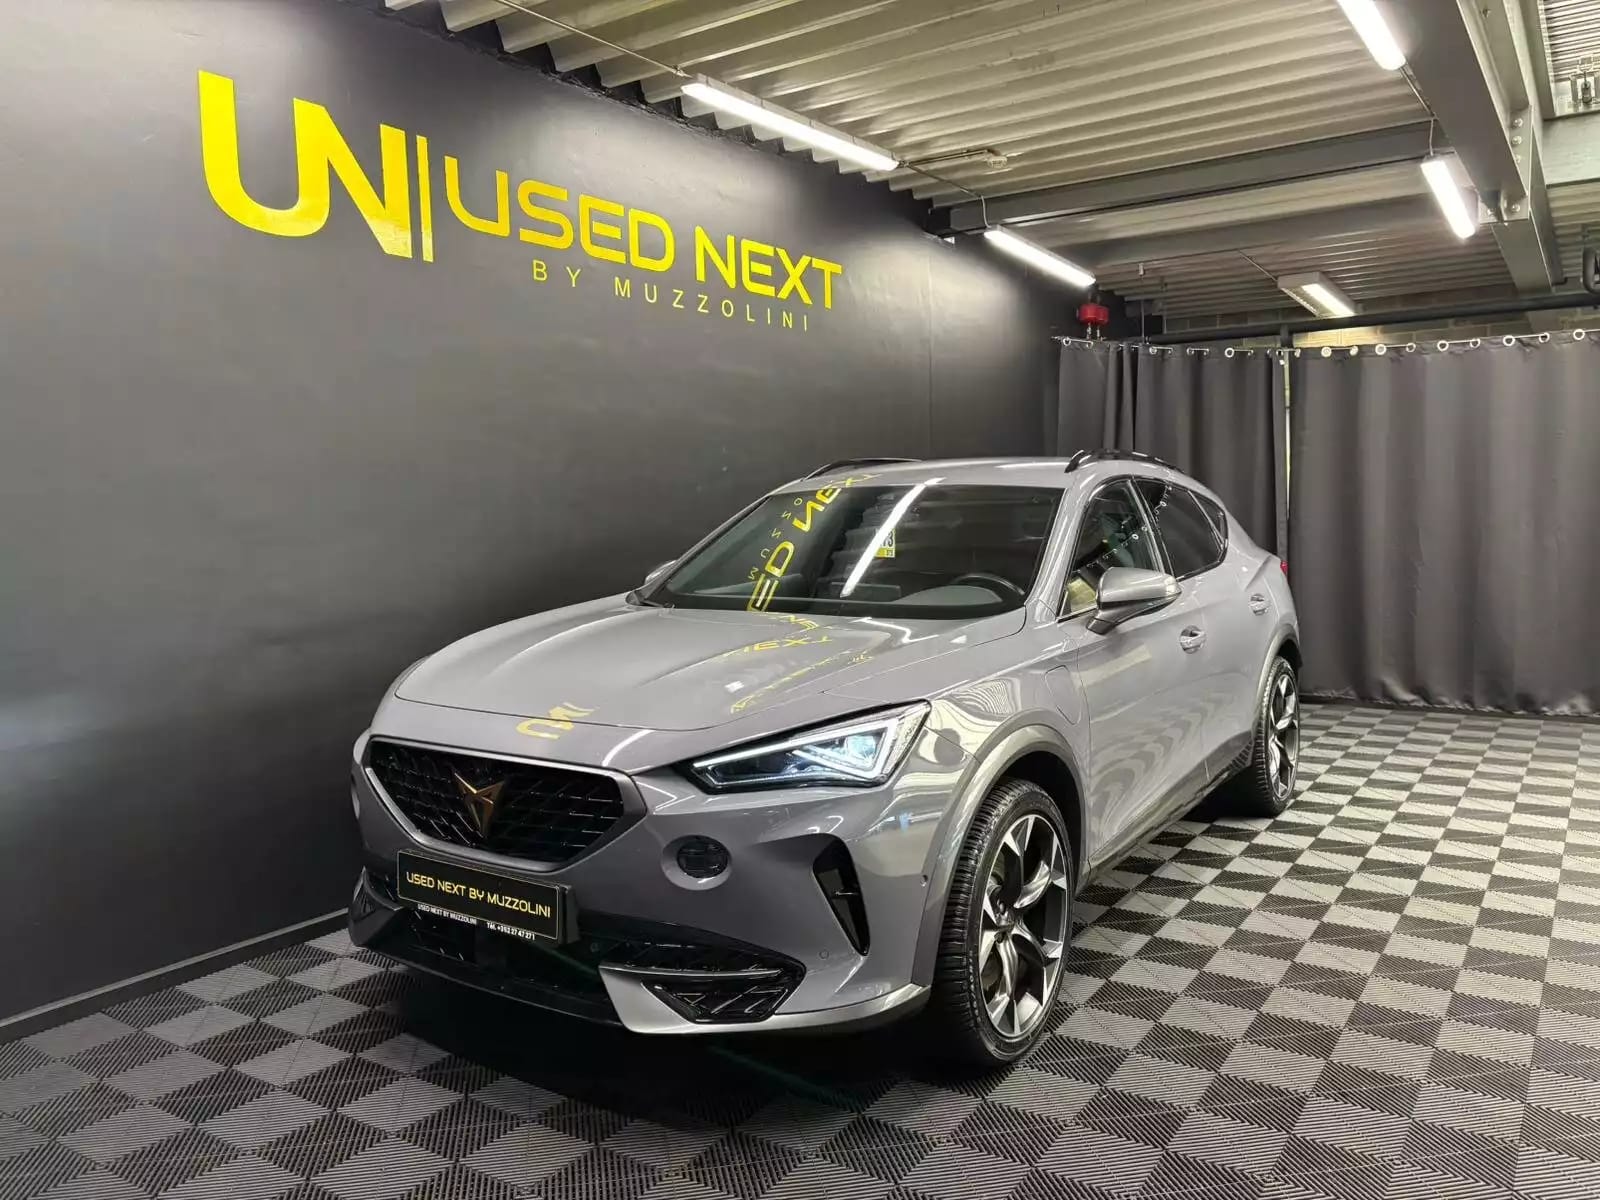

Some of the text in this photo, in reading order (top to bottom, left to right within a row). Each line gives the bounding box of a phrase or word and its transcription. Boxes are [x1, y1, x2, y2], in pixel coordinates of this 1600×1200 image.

[443, 155, 845, 311] USED NEXT
[532, 259, 810, 332] BY MUZZOLINI
[405, 871, 551, 919] USED NEXT BY MUZZOLINI
[417, 903, 430, 912] USED
[430, 906, 443, 916] NEXT
[443, 910, 450, 918] BY
[450, 912, 477, 926] MUZZOLINI
